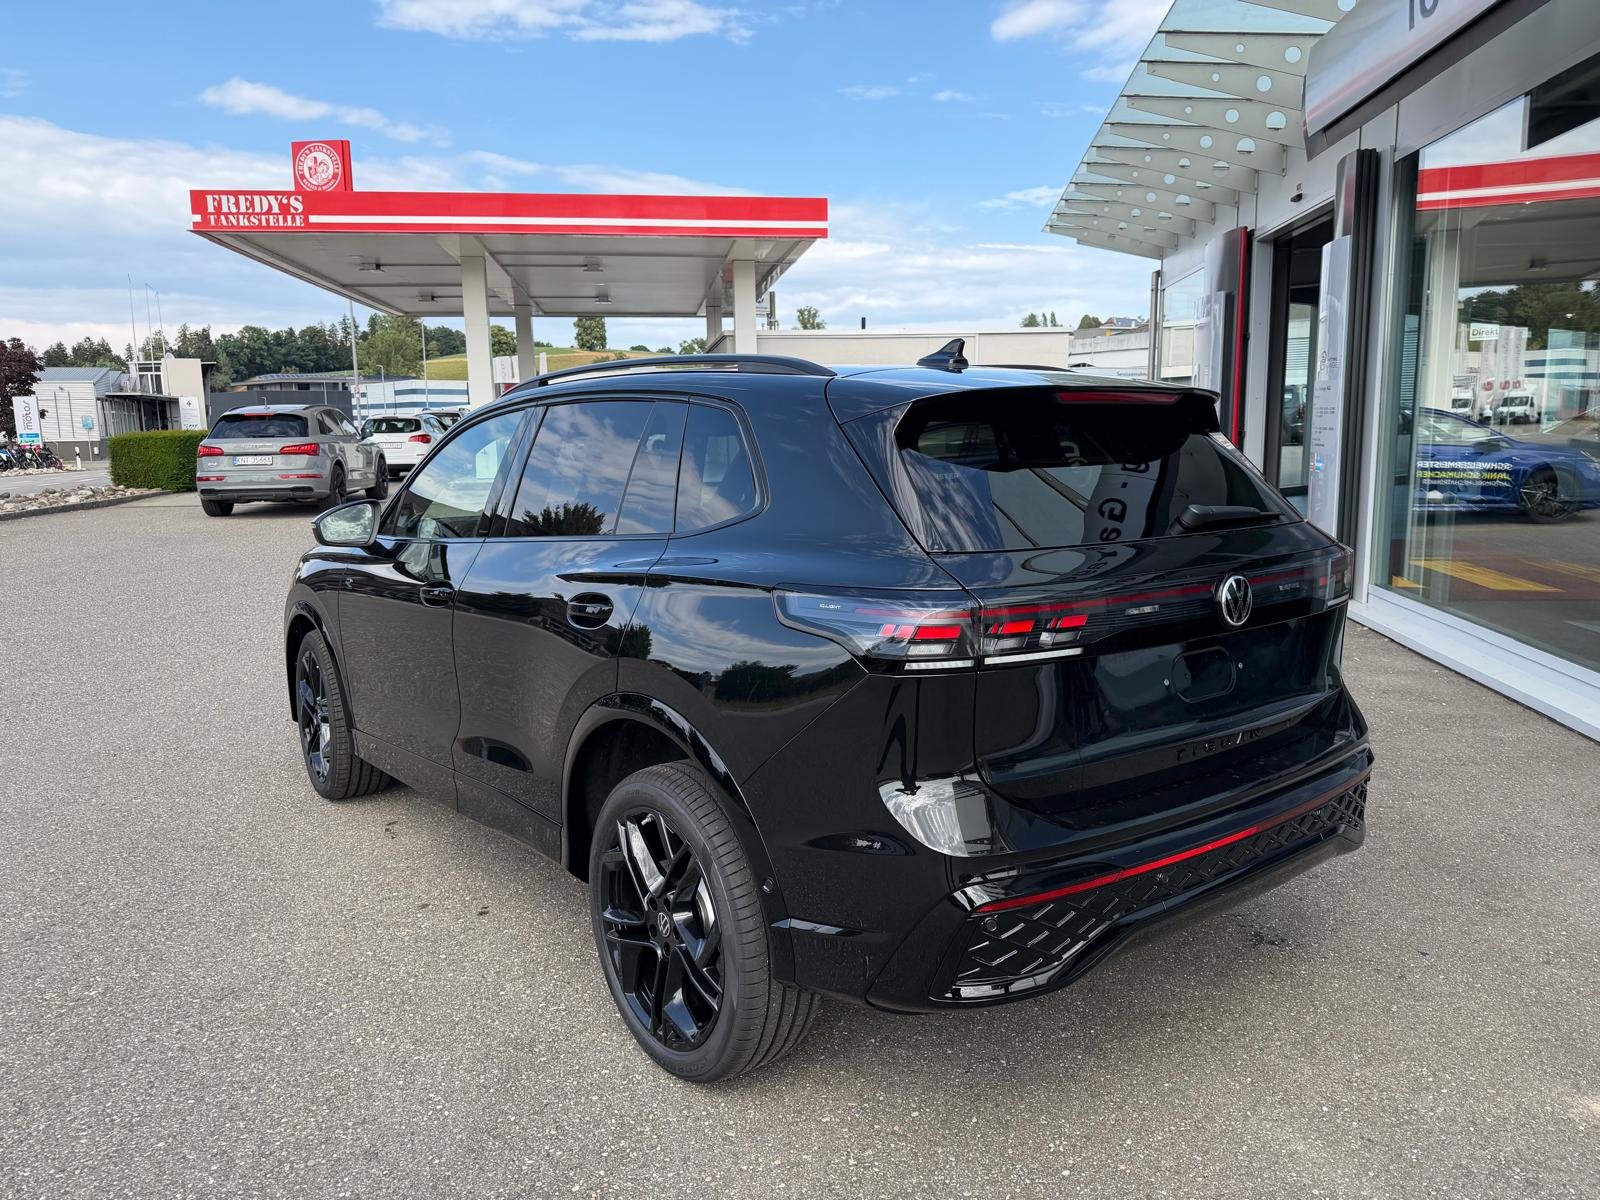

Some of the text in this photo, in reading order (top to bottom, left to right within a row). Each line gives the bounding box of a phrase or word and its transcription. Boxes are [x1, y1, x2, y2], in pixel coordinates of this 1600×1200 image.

[205, 195, 303, 213] FREDY'S
[207, 214, 304, 226] TANKSTELLE
[1472, 328, 1499, 336] Direkt
